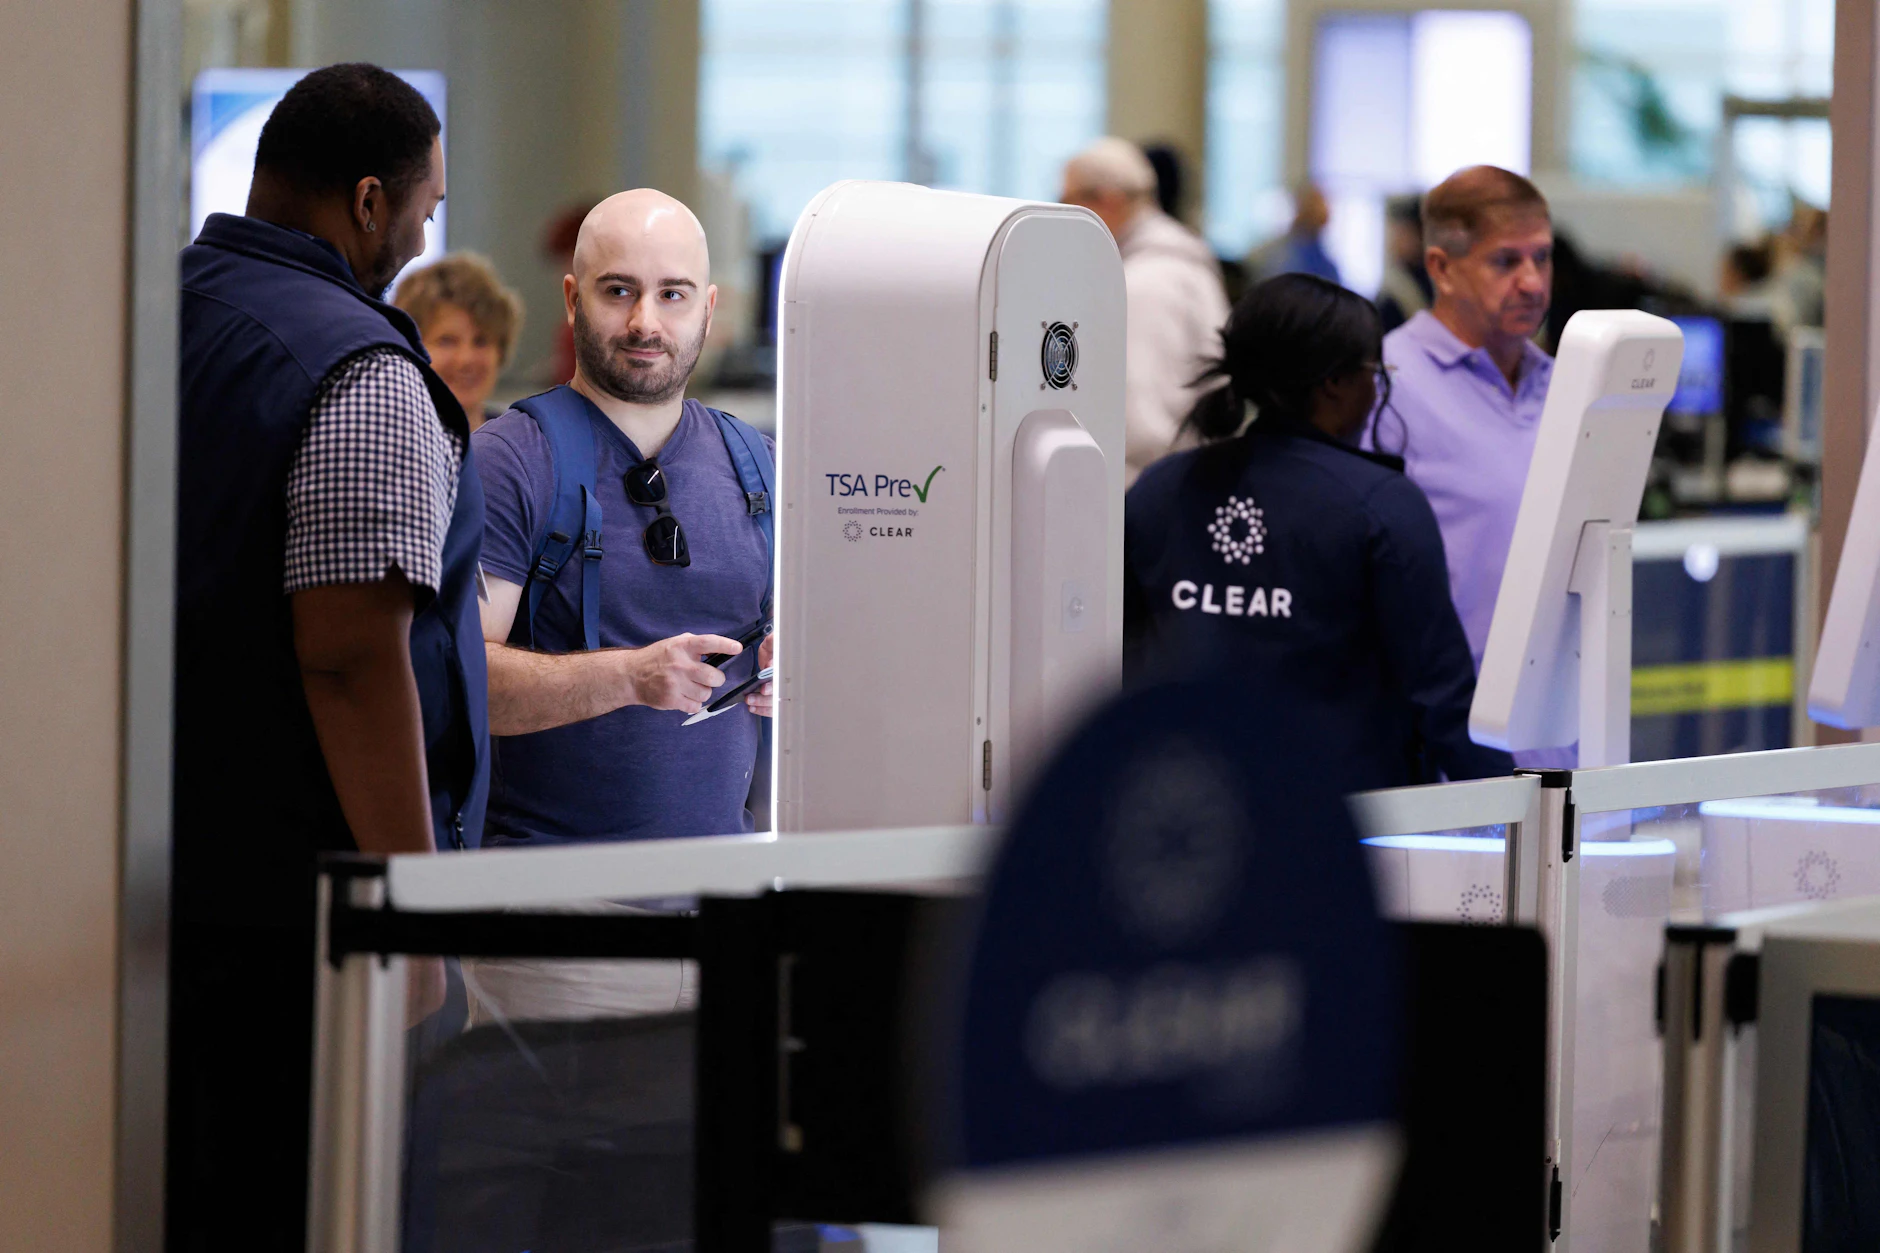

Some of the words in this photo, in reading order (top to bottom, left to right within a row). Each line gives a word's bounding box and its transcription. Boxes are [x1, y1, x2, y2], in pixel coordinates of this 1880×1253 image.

[825, 473, 868, 497] TSA
[875, 474, 912, 498] Pre
[838, 507, 875, 515] Enrollment
[876, 508, 907, 516] Provided
[869, 526, 913, 538] CLEAR
[1171, 579, 1293, 618] CLEAR
